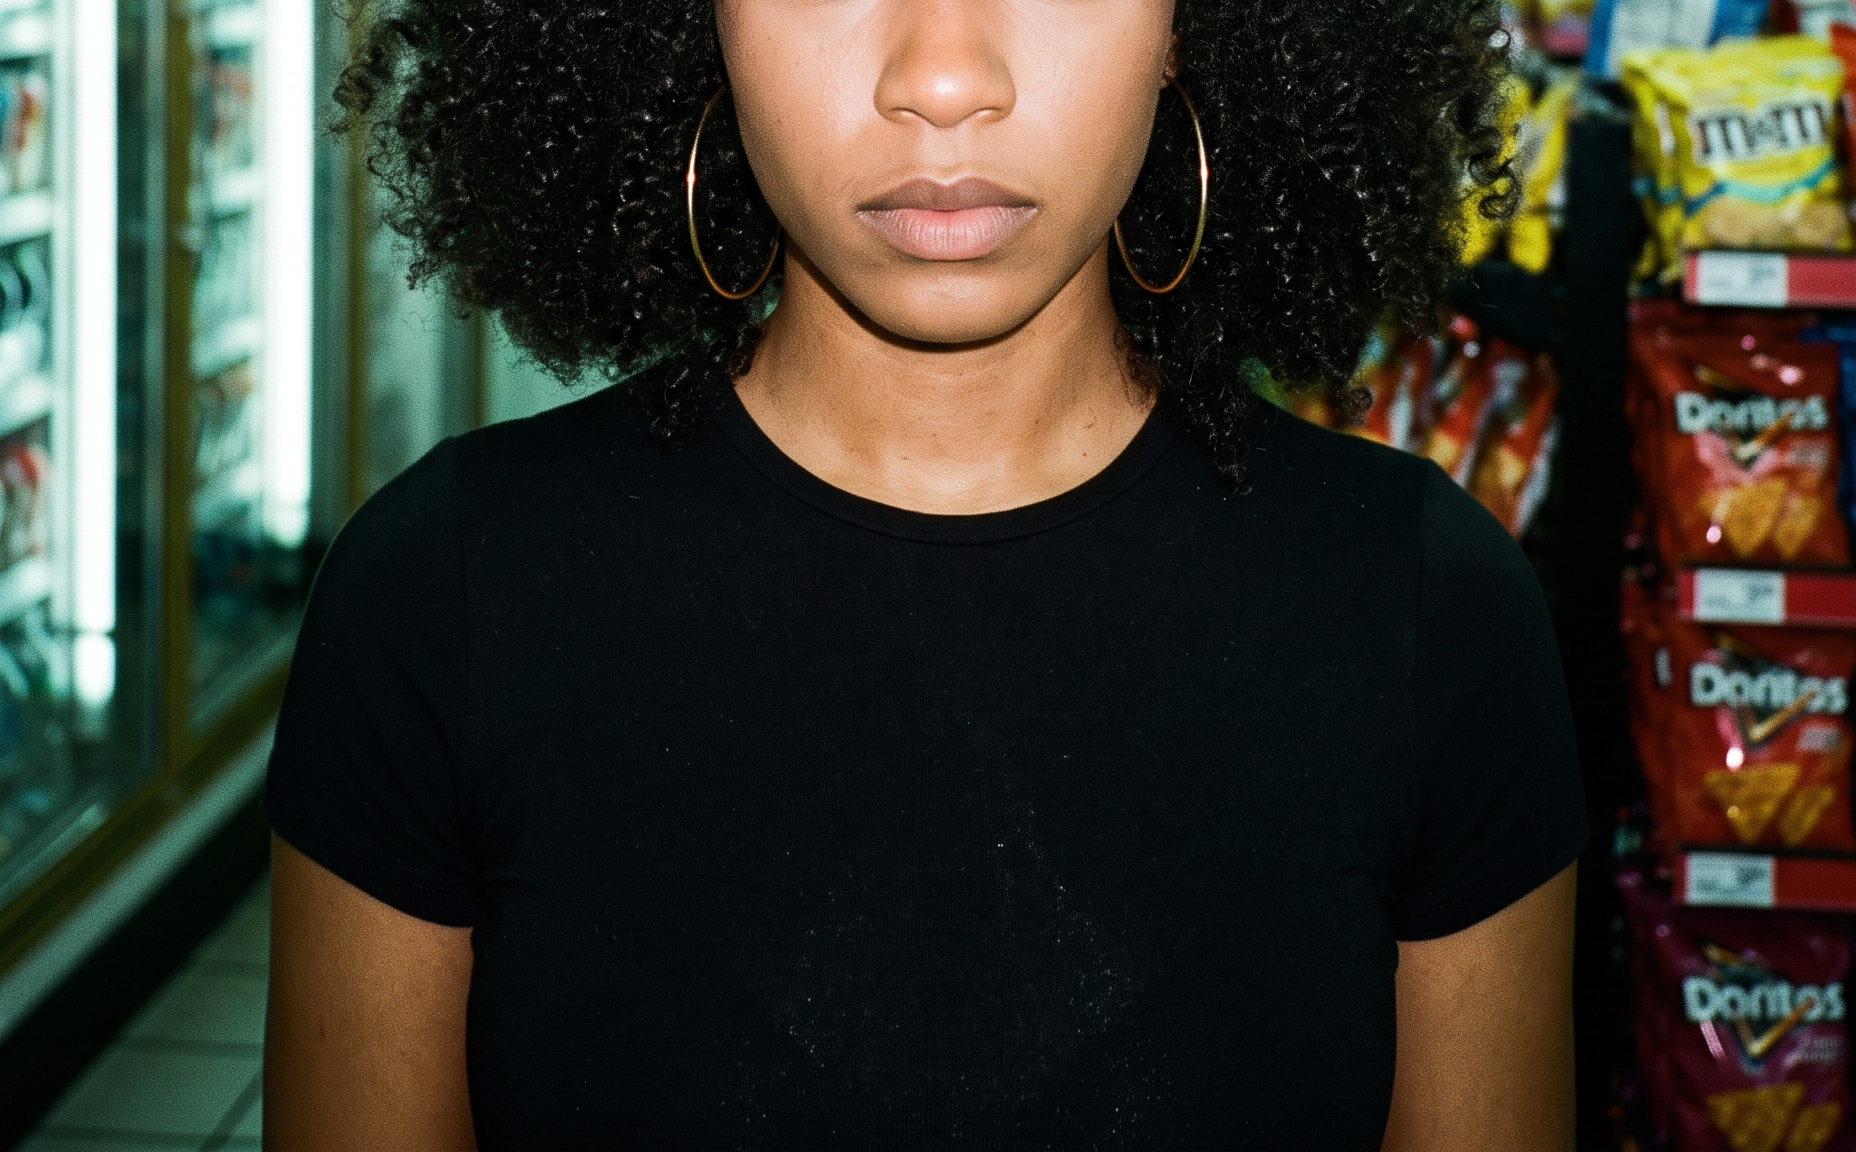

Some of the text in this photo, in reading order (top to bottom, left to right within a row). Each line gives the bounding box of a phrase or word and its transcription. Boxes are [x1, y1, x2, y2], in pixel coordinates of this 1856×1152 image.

[1673, 390, 1830, 433] Doritos
[1689, 661, 1849, 714] Doritos
[1682, 976, 1847, 1023] Doritos
